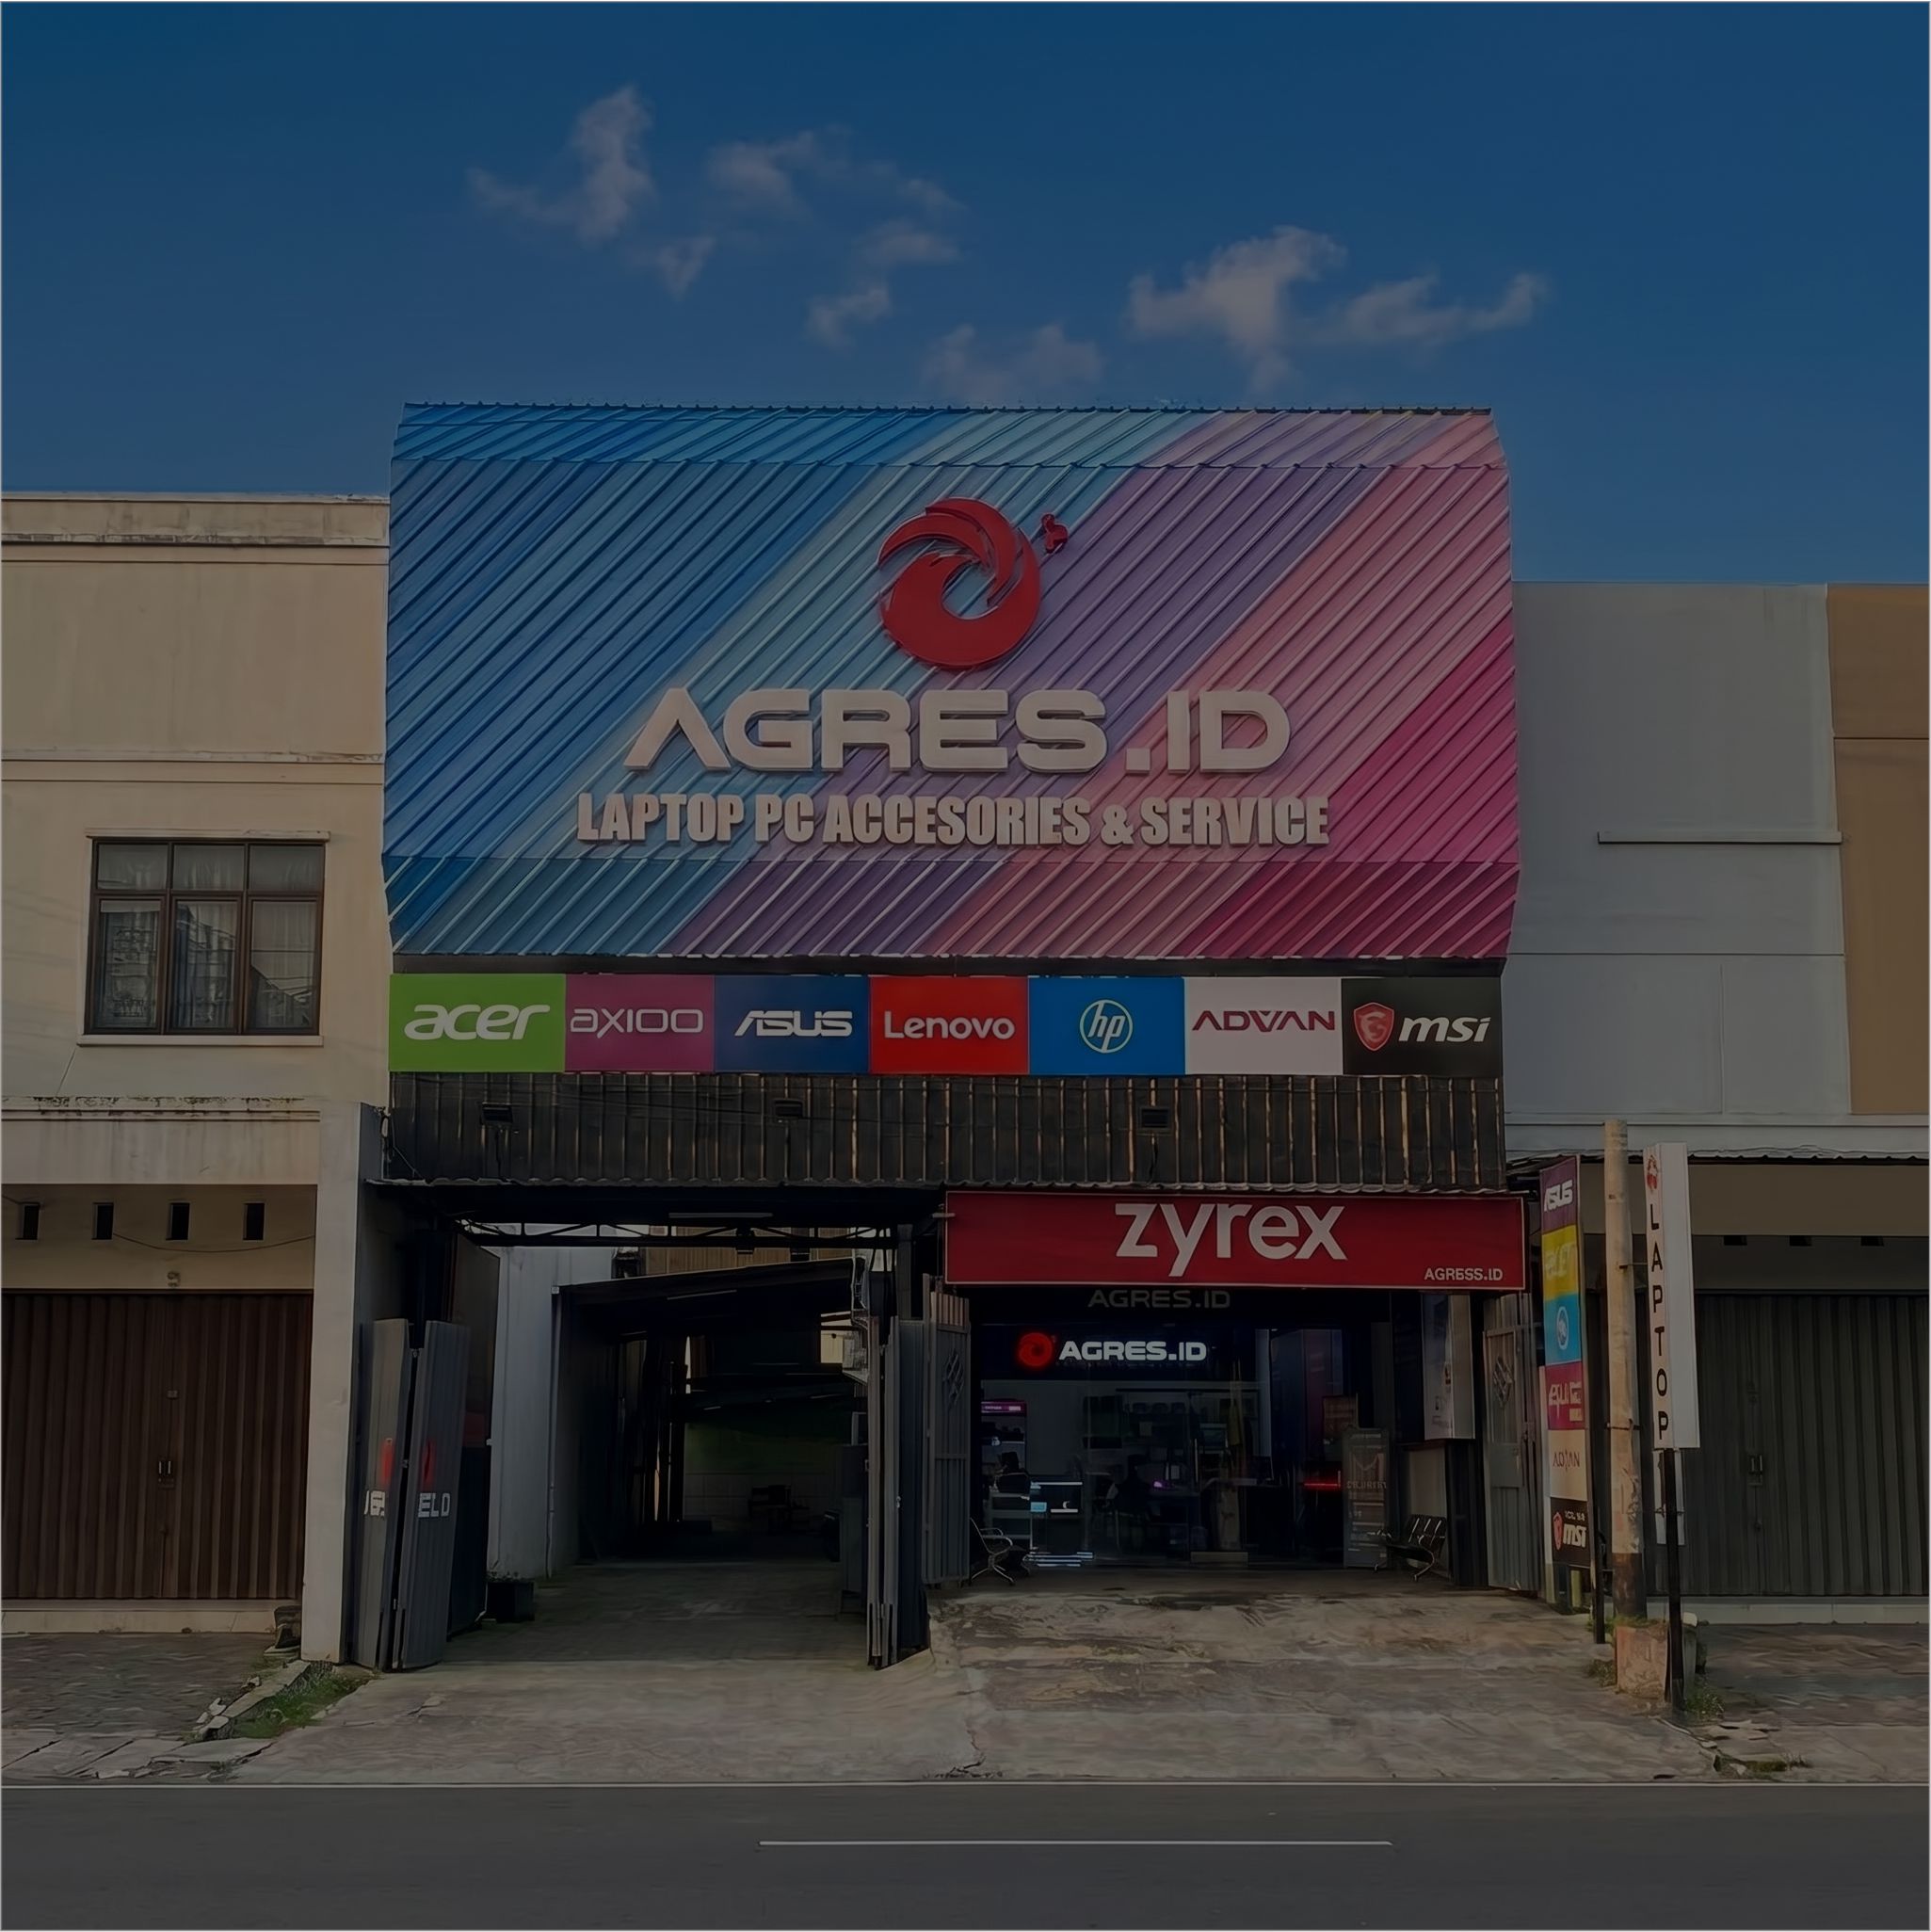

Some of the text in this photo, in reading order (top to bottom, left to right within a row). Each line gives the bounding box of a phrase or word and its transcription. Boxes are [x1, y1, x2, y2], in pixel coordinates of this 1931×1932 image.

[576, 792, 1330, 847] LAPTOP PC ACCESORIES & SERVICE
[404, 1004, 551, 1040] acer
[733, 1010, 853, 1037] ASUS
[884, 1010, 1016, 1041] Lenovo
[1192, 1010, 1335, 1033] ADVAN
[1399, 1016, 1490, 1042] msi
[1115, 1202, 1347, 1278] zyrex
[1087, 1290, 1231, 1310] AGRES.ID
[1649, 1203, 1669, 1441] LAPTOP
[1058, 1340, 1208, 1361] AGRES.ID
